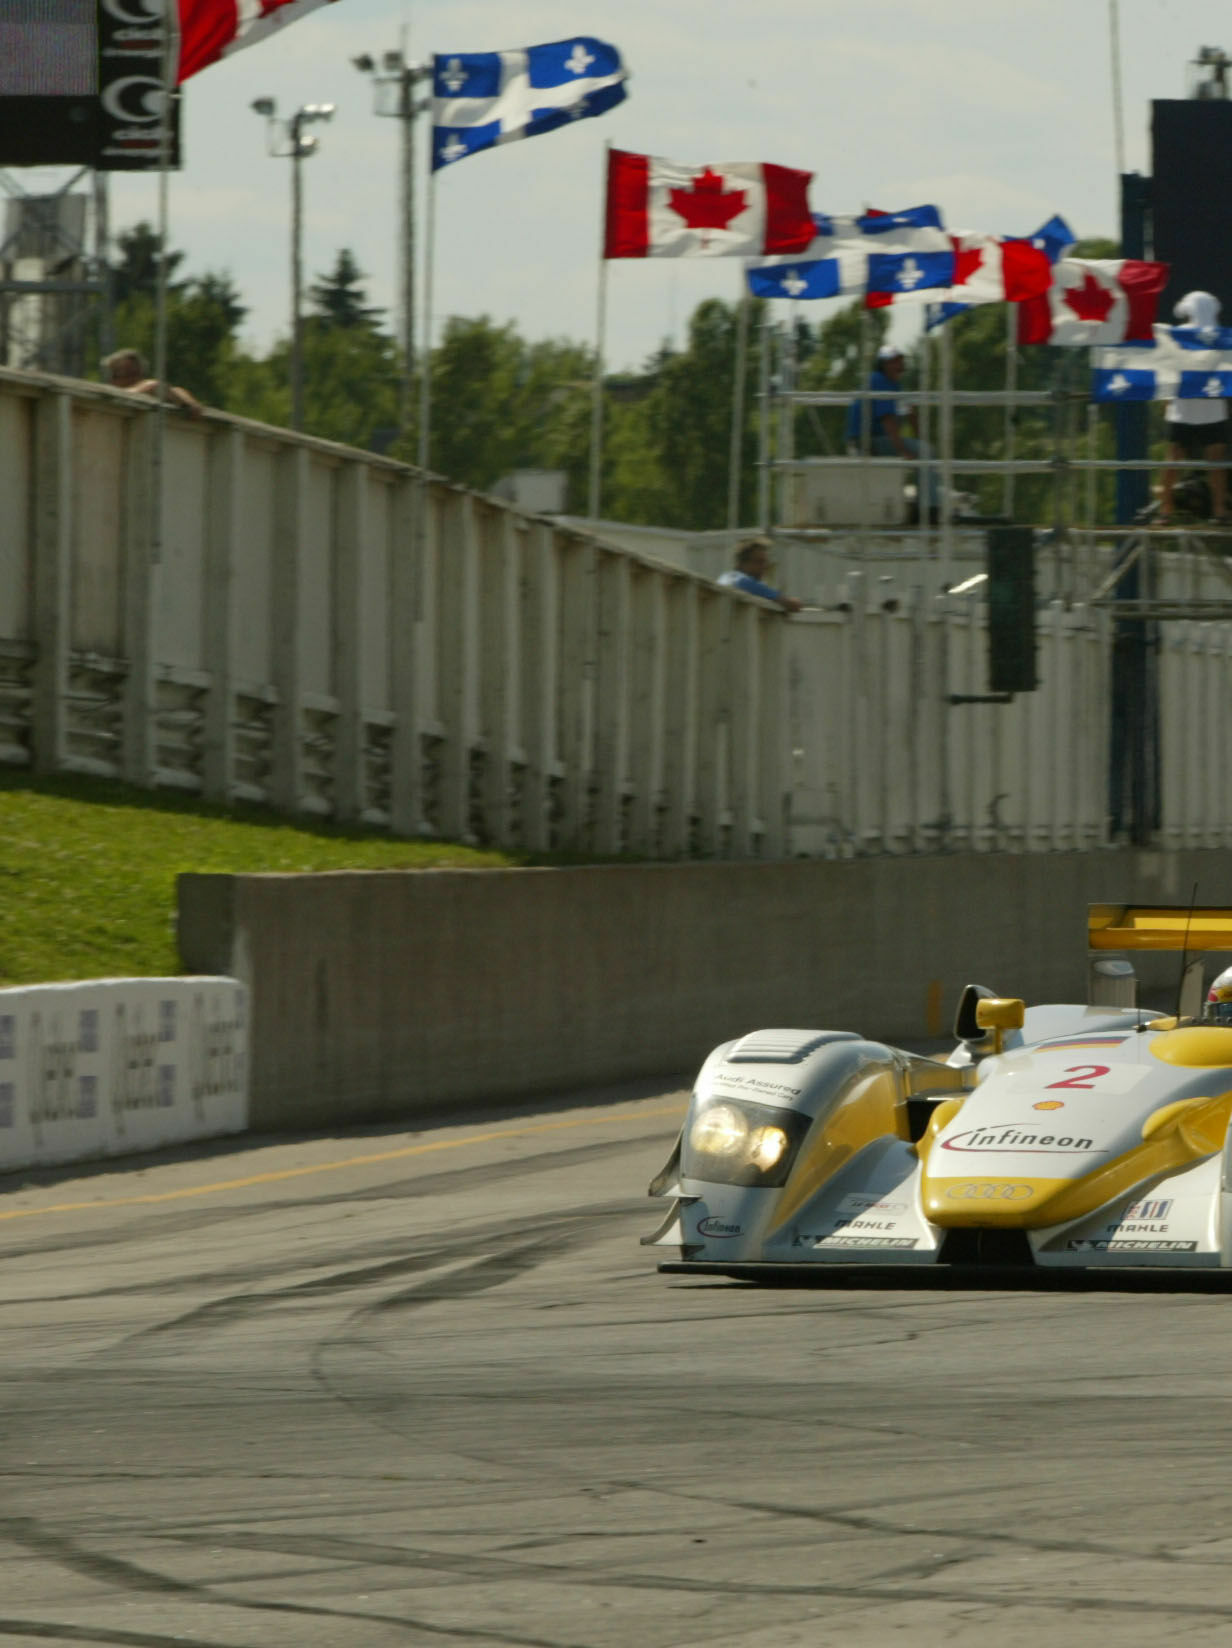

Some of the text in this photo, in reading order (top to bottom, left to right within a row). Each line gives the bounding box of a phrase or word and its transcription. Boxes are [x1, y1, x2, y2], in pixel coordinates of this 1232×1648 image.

[1045, 1065, 1111, 1090] 2
[1106, 1224, 1169, 1233] MAHLE
[1096, 1241, 1193, 1250] MICHELIN
